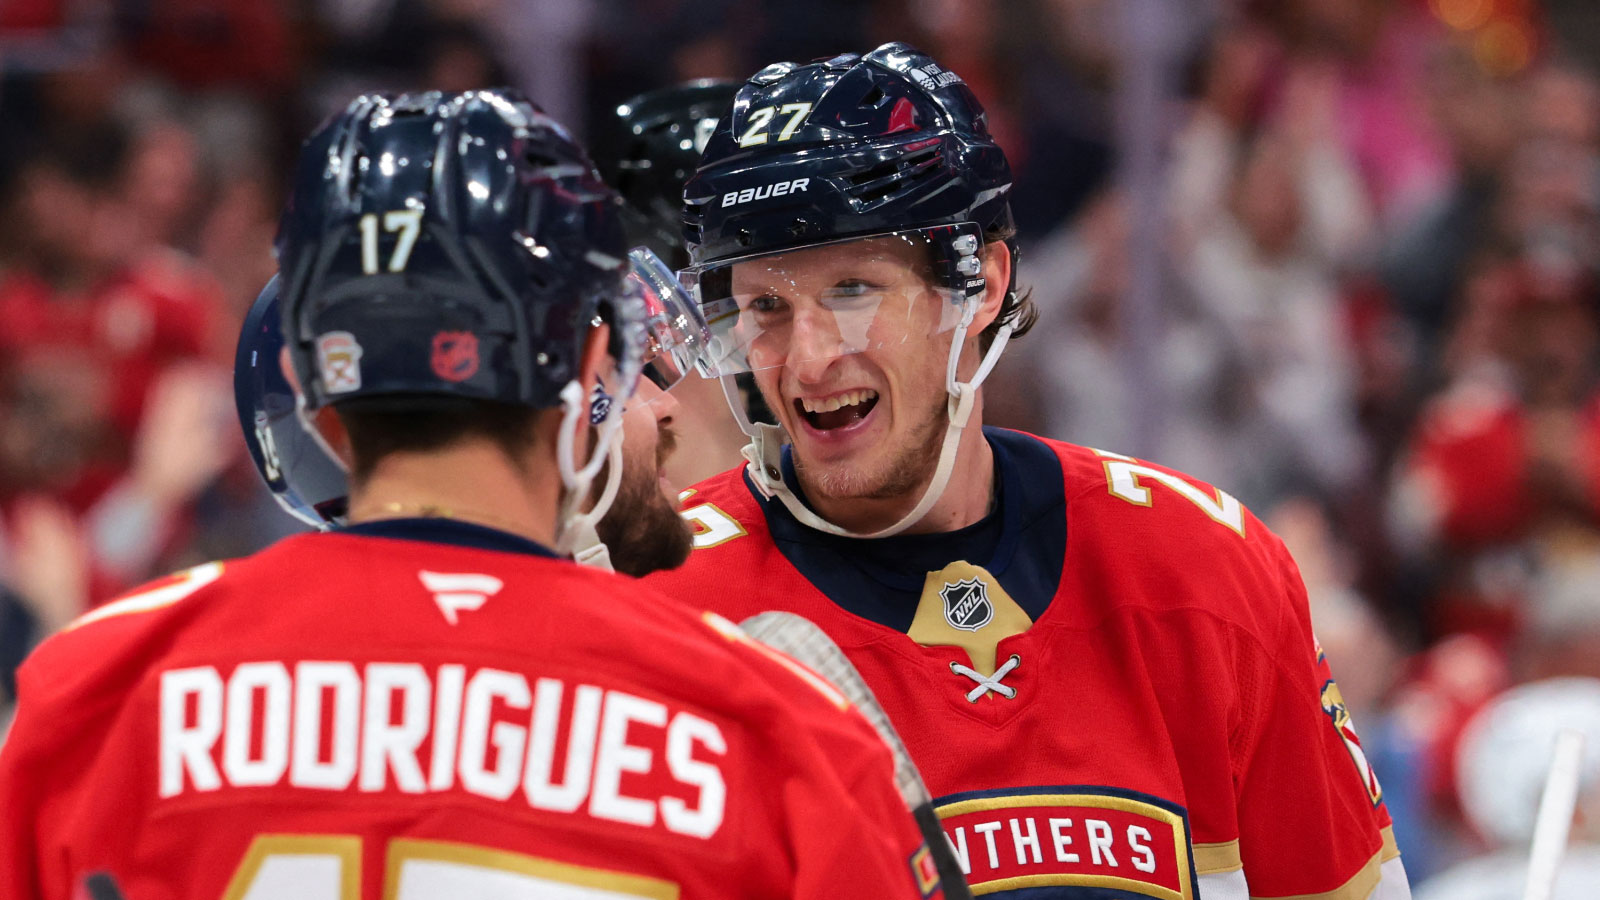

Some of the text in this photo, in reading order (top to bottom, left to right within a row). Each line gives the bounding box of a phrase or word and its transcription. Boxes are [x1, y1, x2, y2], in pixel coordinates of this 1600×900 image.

[740, 102, 813, 149] 27
[721, 178, 810, 208] BAUER
[359, 210, 424, 275] 17
[967, 279, 984, 288] BAUER
[954, 591, 980, 623] NHL
[158, 660, 728, 840] RODRIGUES
